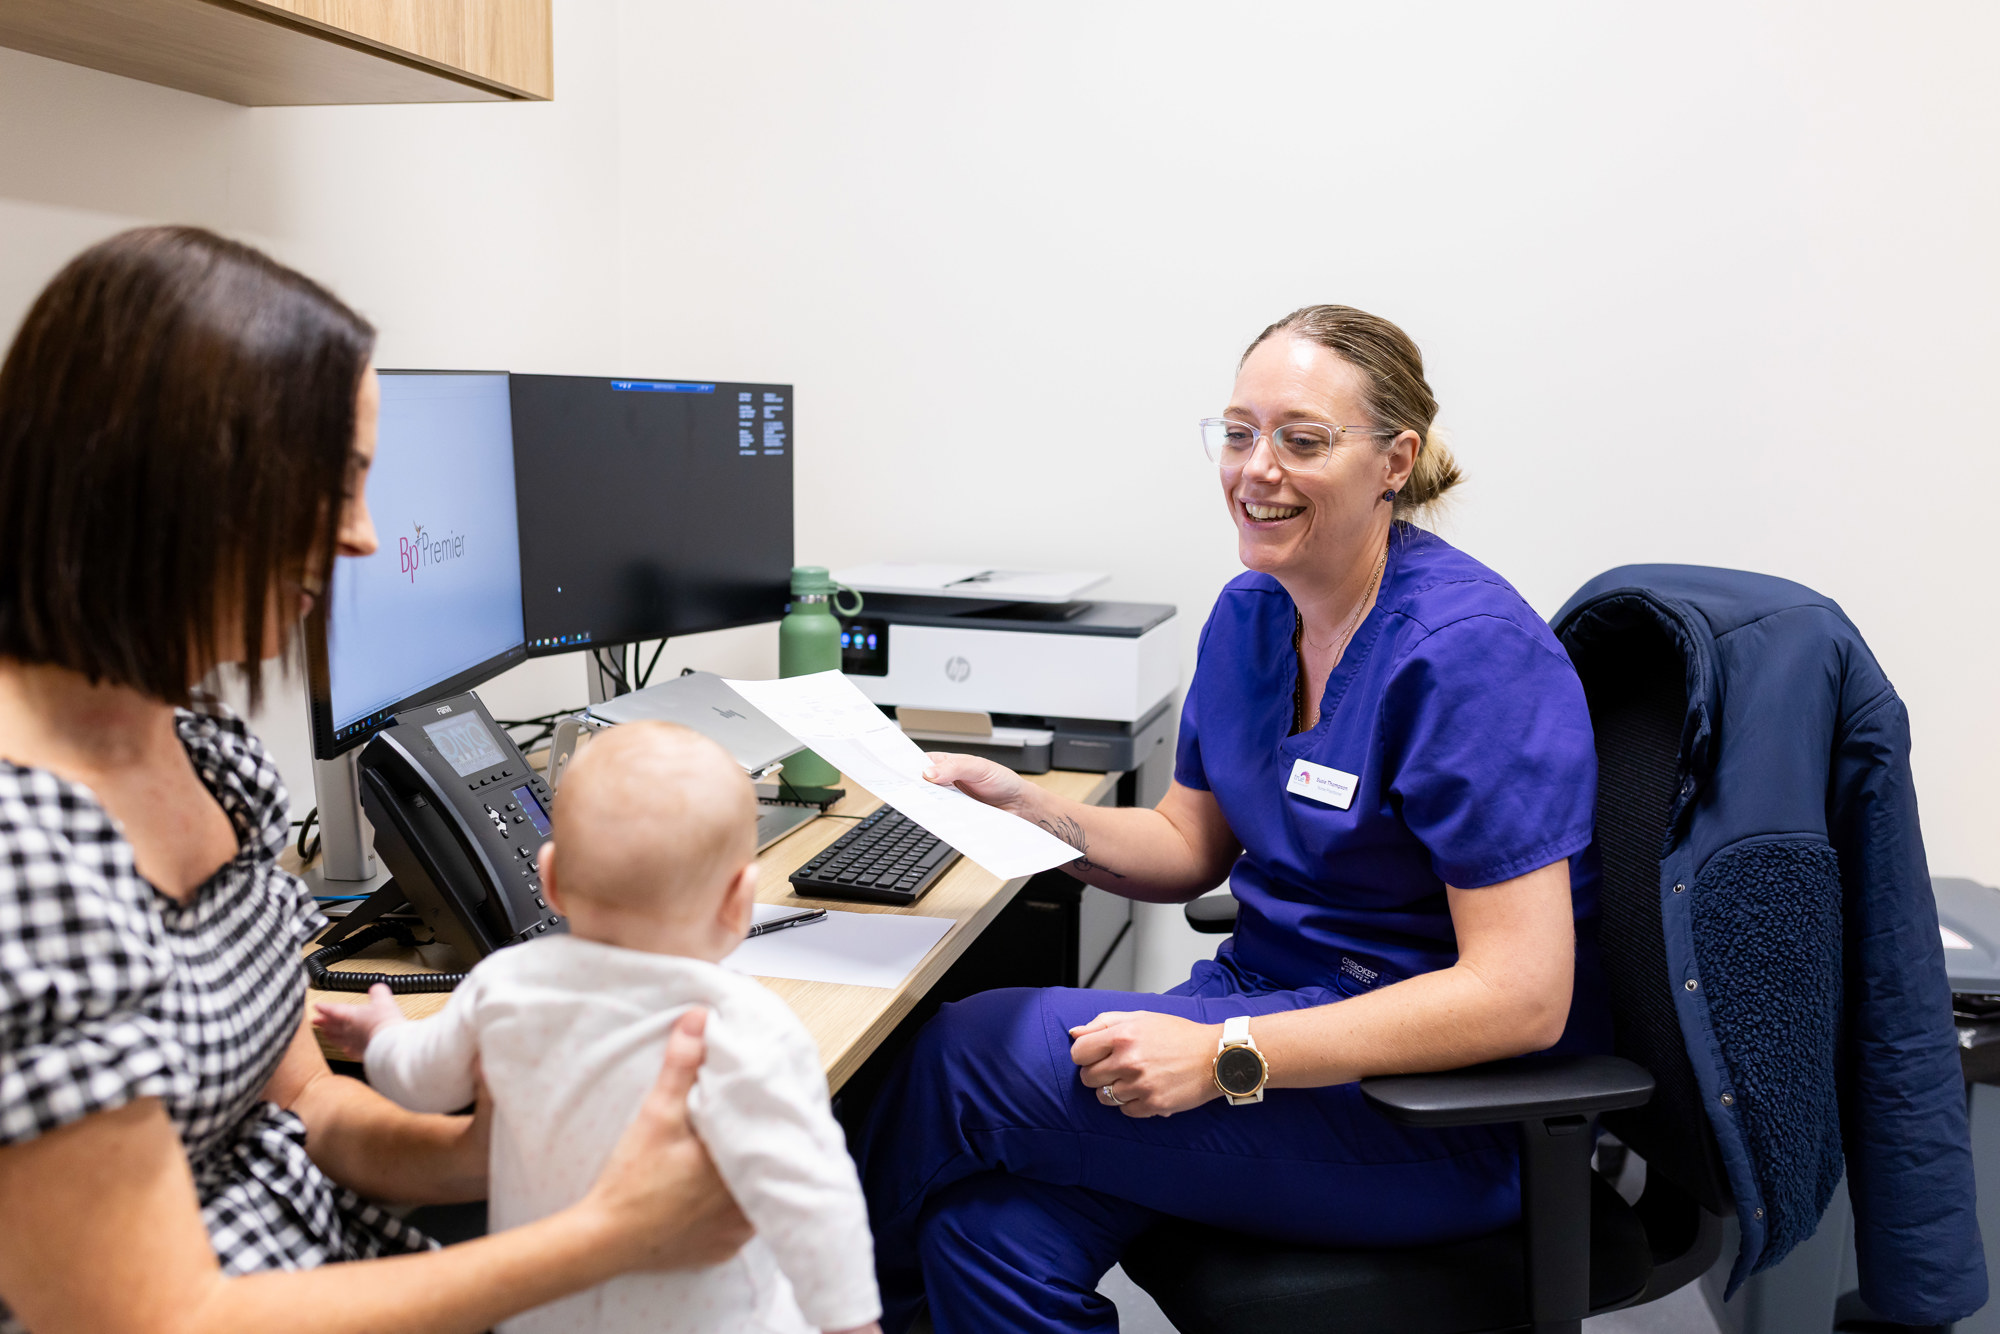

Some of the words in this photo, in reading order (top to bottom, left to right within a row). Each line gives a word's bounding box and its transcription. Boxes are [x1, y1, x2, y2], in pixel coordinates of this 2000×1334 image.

[399, 536, 419, 584] Bp
[421, 530, 466, 567] Premier
[1340, 966, 1371, 984] WORKWEAR
[1341, 956, 1376, 979] CHEROKEE
